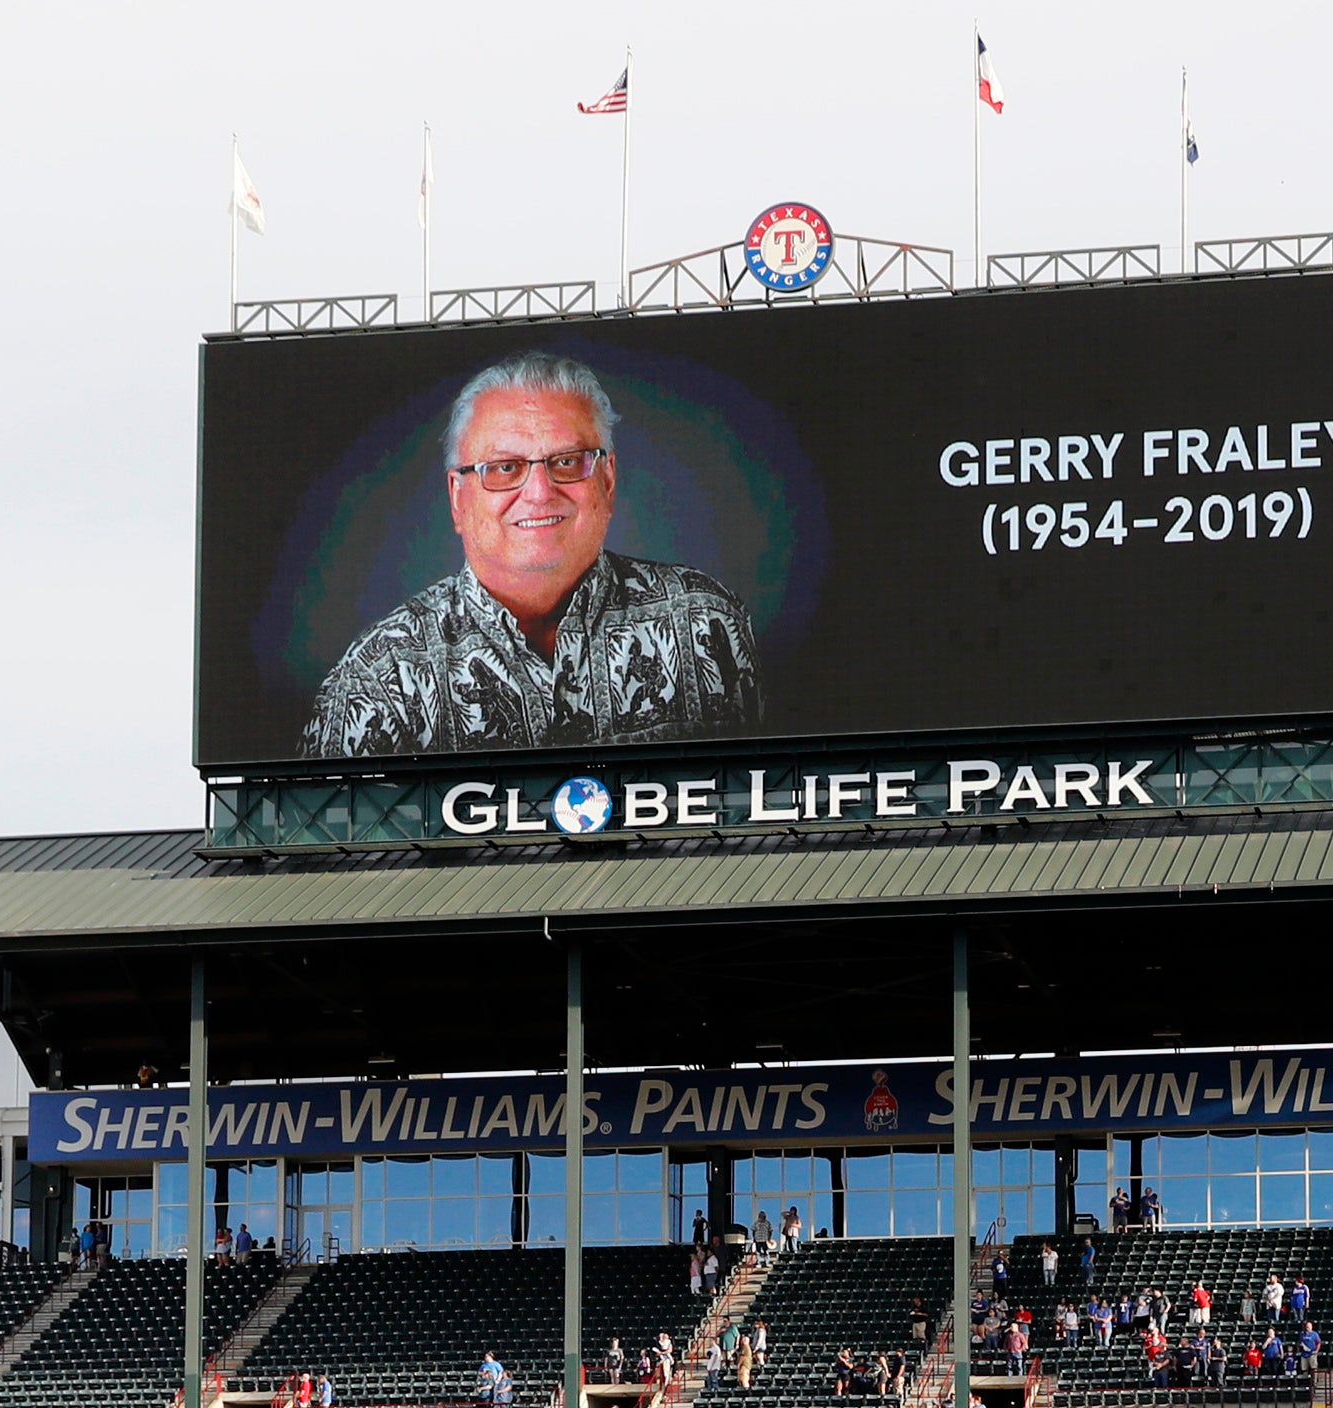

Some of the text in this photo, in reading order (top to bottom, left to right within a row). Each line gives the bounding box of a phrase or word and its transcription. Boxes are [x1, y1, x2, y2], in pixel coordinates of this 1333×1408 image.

[757, 207, 821, 231] TEXAS
[751, 250, 827, 286] RANGERS
[774, 229, 806, 266] T
[939, 432, 1125, 488] GERRY
[981, 486, 1314, 555] (1954-2019)
[630, 1079, 830, 1135] PAINTS
